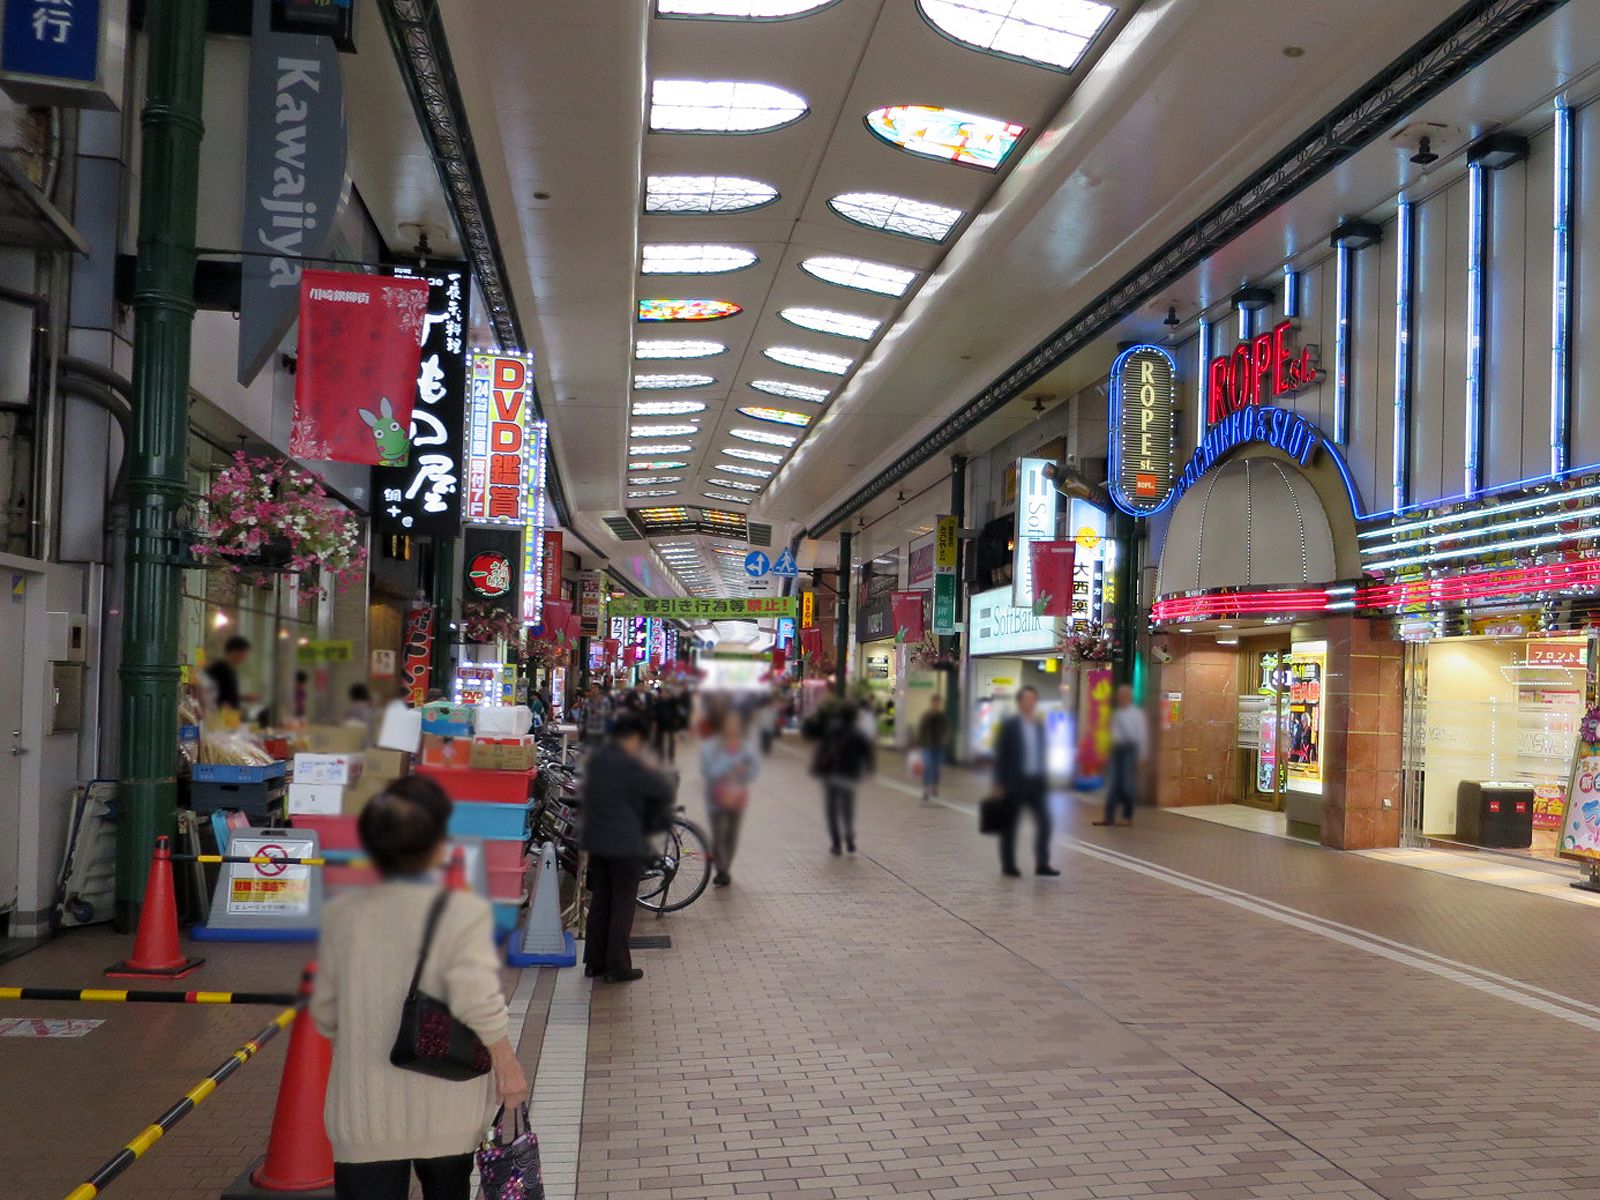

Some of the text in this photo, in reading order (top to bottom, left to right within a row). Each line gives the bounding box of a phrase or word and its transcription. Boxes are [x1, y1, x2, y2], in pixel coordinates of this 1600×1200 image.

[258, 57, 320, 289] Kawajiya
[1139, 361, 1156, 456] ROPE
[1209, 319, 1293, 425] ROPE
[489, 358, 526, 519] DVD鑑賞
[1176, 405, 1255, 498] PACHINKO
[1269, 408, 1317, 466] SLOT
